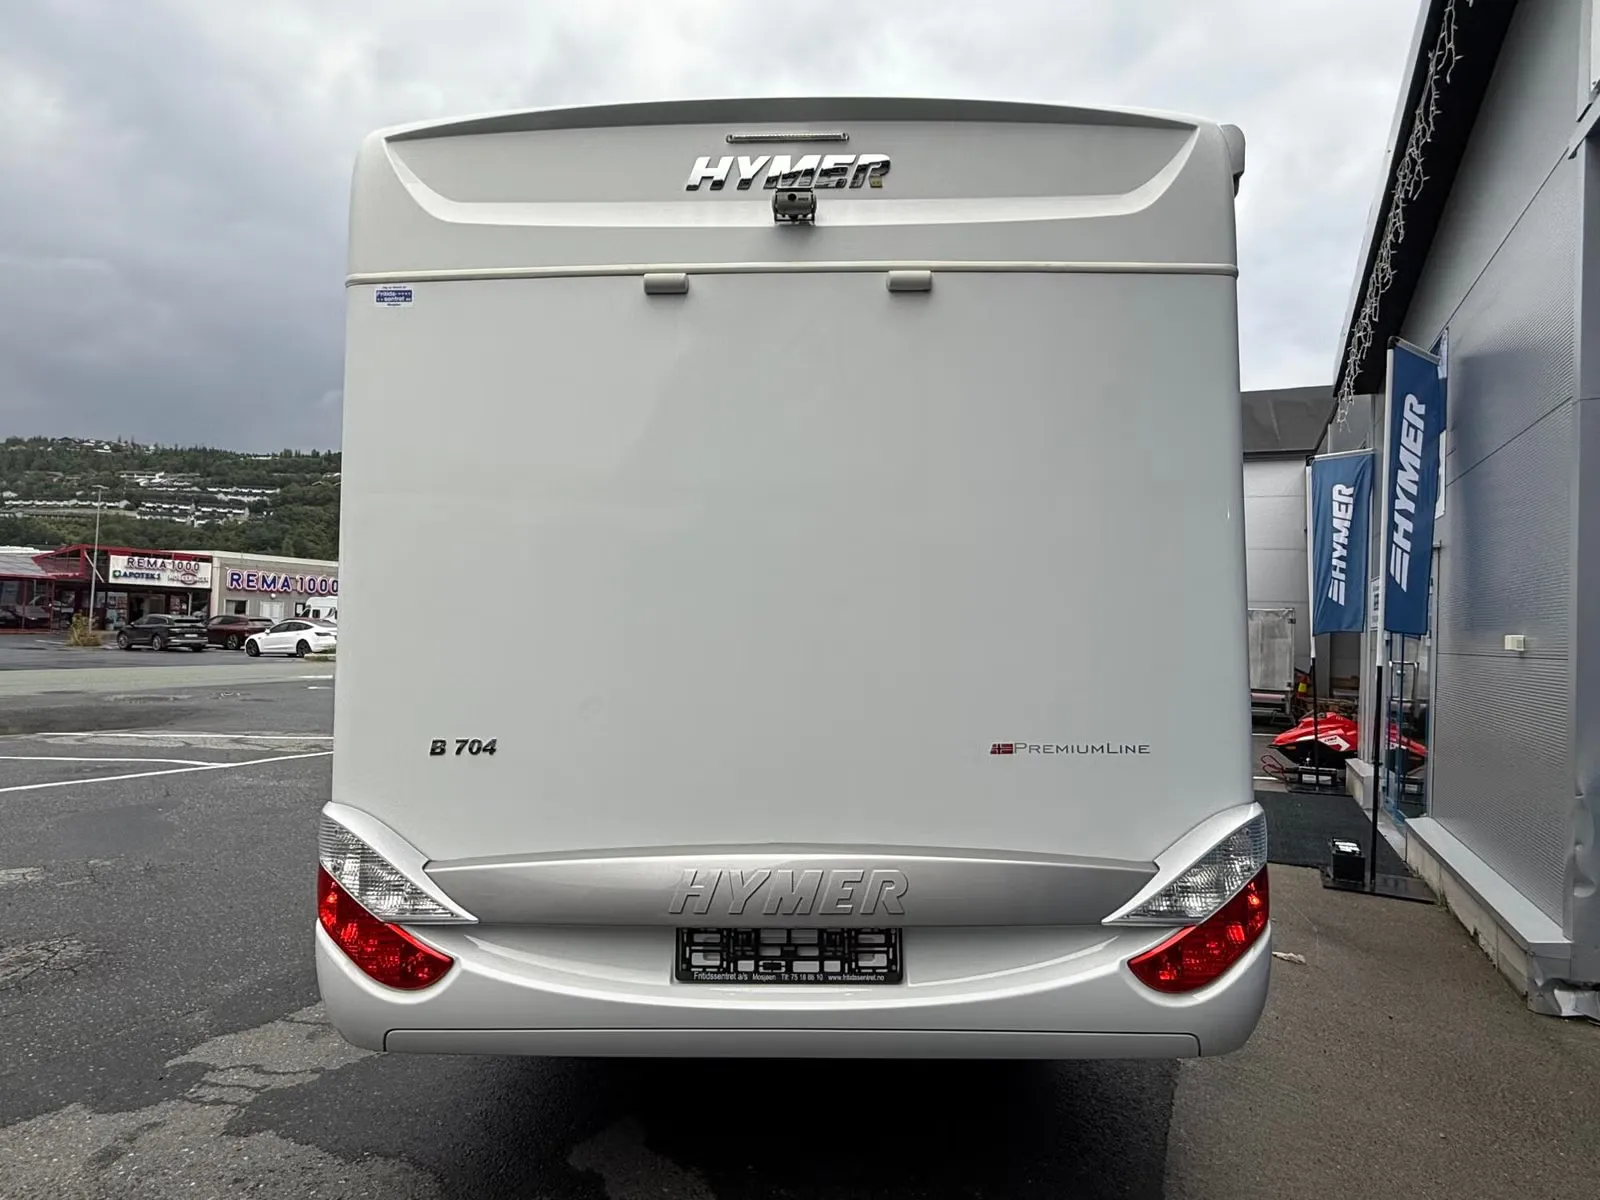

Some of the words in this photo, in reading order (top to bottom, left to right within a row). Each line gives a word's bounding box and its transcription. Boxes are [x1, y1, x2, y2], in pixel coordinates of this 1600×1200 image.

[685, 154, 891, 191] HYMER
[1392, 393, 1426, 544] HYMER
[1331, 483, 1355, 580] HYMER
[122, 570, 156, 580] APOTEK
[126, 557, 168, 570] REMA
[171, 561, 201, 572] 1000
[227, 569, 292, 592] REMA
[429, 739, 447, 756] B
[455, 739, 497, 756] 704
[668, 868, 909, 916] HYMER
[693, 972, 737, 981] Fritidssentret
